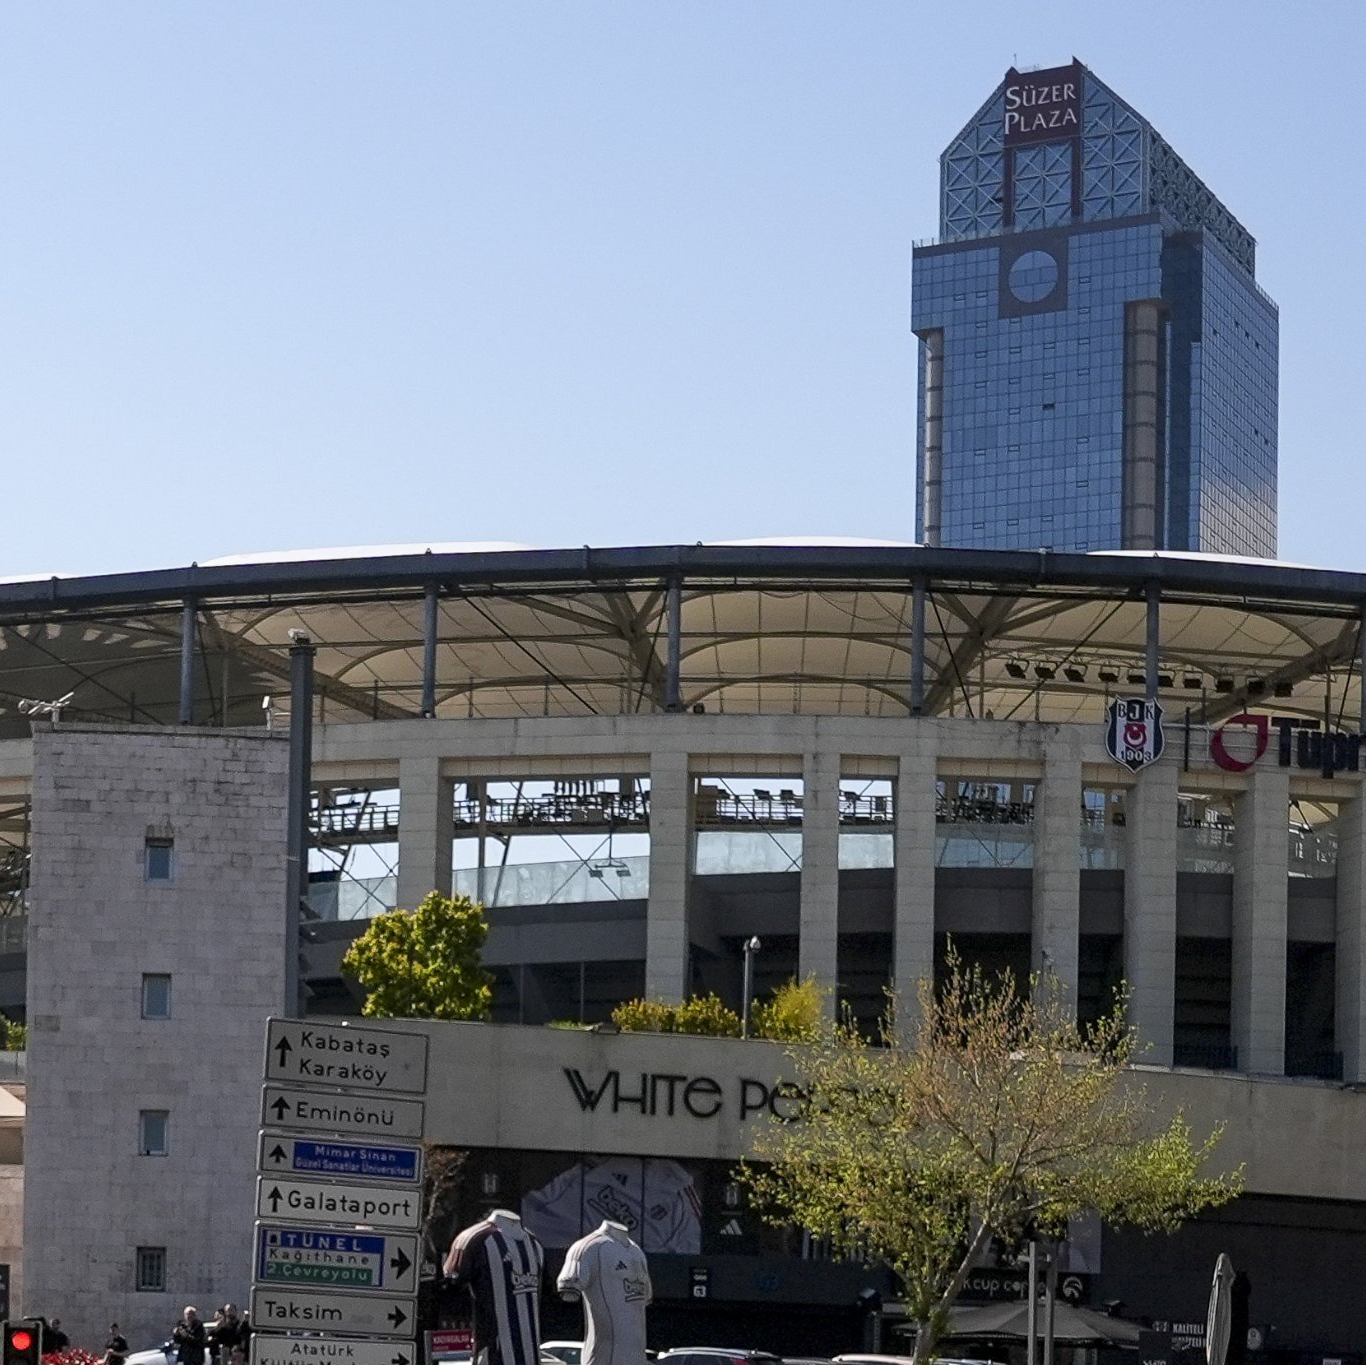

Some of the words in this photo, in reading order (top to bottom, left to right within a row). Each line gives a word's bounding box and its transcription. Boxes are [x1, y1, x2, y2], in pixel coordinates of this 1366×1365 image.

[1006, 83, 1076, 109] SÜZER
[1004, 108, 1077, 135] PLAZA
[1120, 750, 1153, 762] 1903
[301, 1032, 390, 1058] Kabataş
[299, 1058, 388, 1086] Karaköy
[296, 1101, 394, 1126] Eminönü
[315, 1146, 355, 1158] Mimar
[360, 1149, 396, 1161] Sinan
[288, 1190, 411, 1218] Galataport
[287, 1234, 362, 1250] TÜNEL
[269, 1248, 370, 1265] Kağıthane
[973, 1279, 1000, 1297] cup
[265, 1301, 343, 1321] Taksim
[291, 1343, 354, 1357] Atatürk
